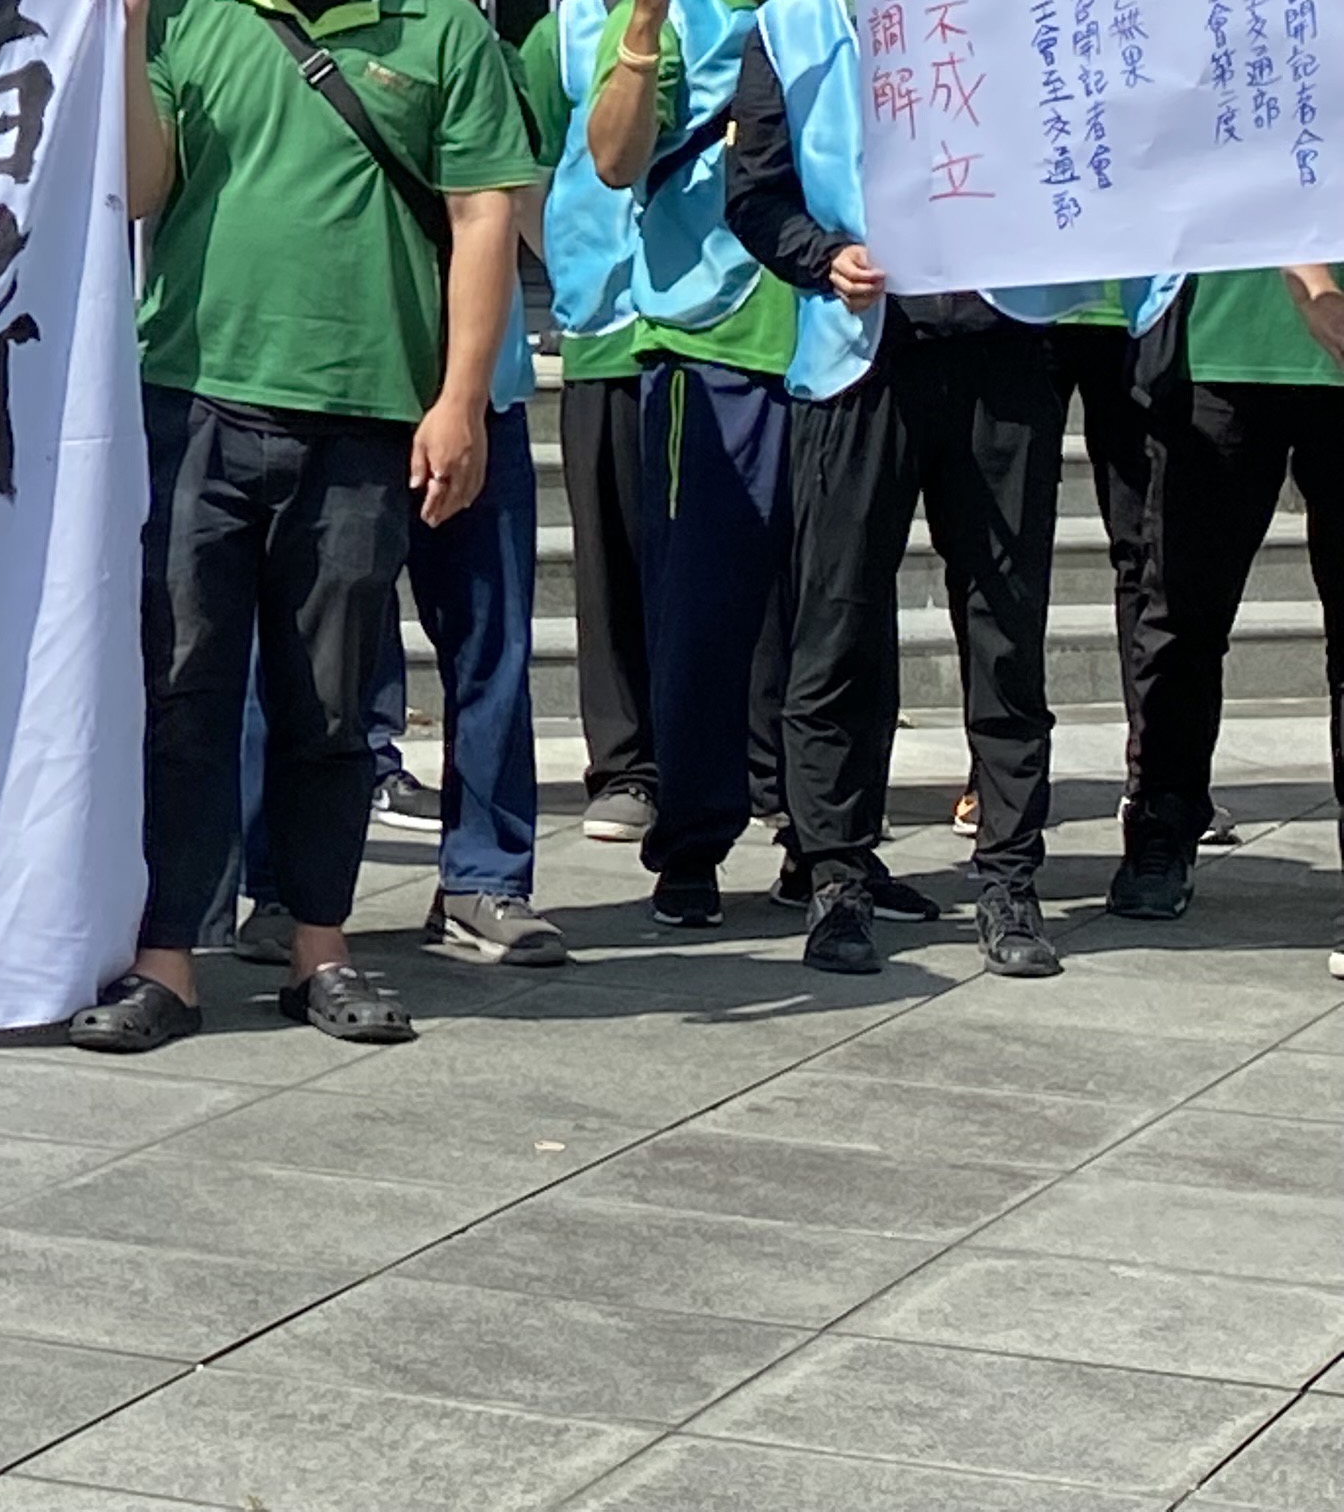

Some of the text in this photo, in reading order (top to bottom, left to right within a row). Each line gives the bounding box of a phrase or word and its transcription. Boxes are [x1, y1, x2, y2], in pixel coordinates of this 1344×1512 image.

[867, 3, 923, 139] 調解
[1031, 0, 1083, 230] 工會至交通部
